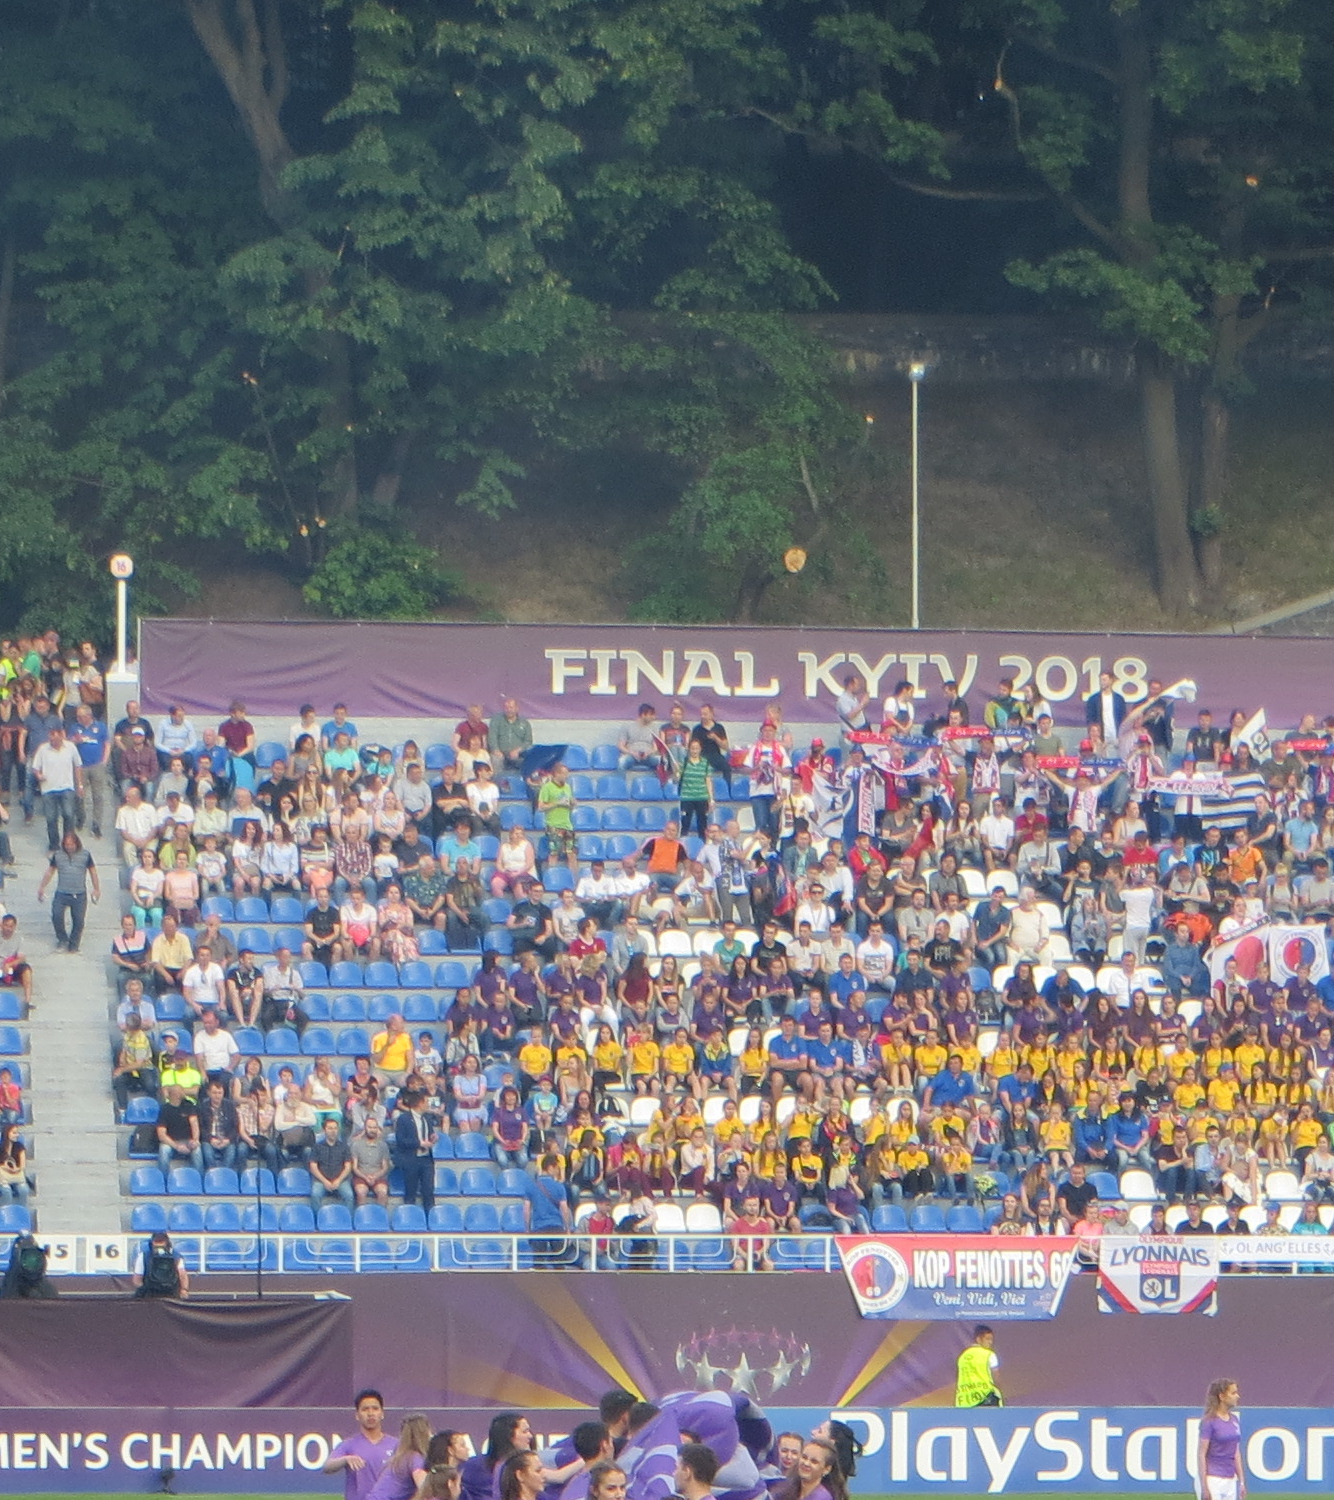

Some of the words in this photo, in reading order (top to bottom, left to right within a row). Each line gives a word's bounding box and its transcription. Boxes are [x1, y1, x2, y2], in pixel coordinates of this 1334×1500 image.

[543, 648, 780, 697] FINAL
[797, 651, 978, 699] KYIV
[998, 655, 1149, 703] 2018
[94, 1243, 119, 1259] 16
[1110, 1246, 1211, 1267] LYONNAIS
[913, 1250, 950, 1289] KOP
[954, 1250, 1046, 1290] FENOTTES
